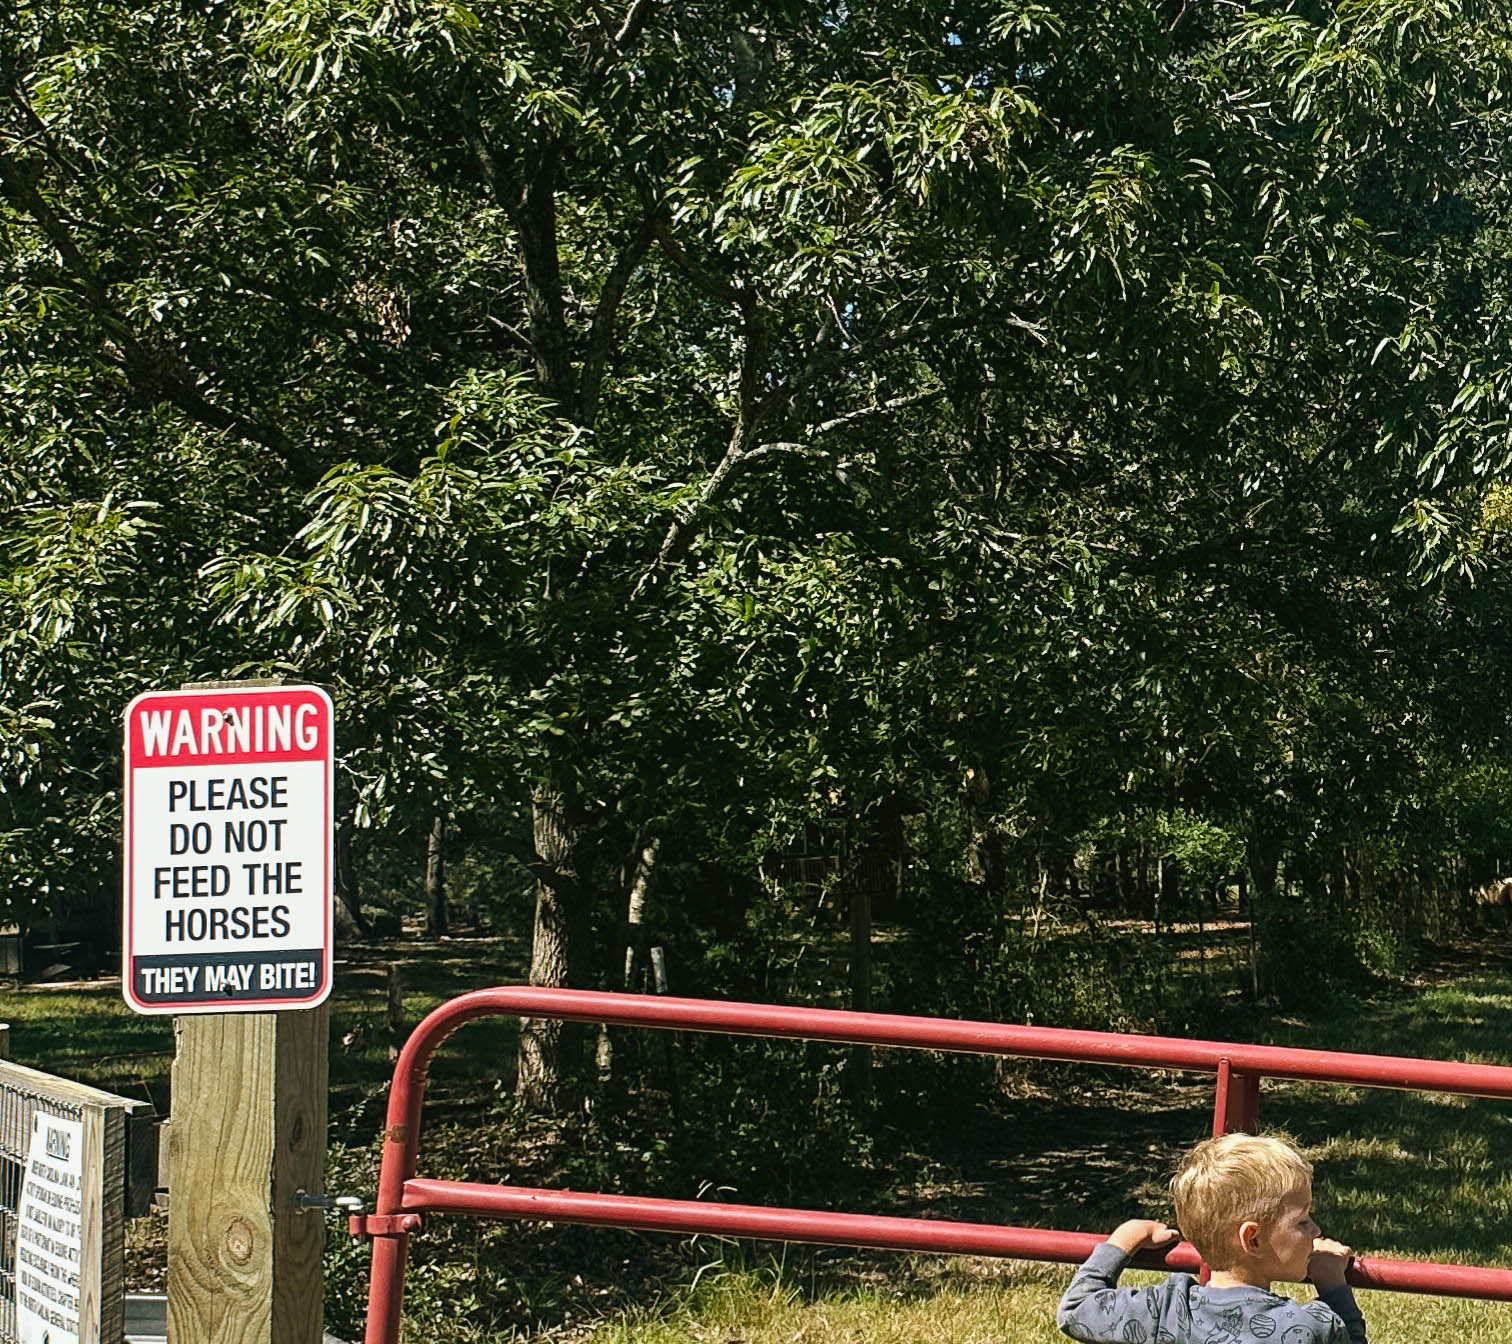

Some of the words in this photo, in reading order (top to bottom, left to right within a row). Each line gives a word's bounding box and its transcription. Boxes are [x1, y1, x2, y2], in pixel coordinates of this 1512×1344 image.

[140, 703, 319, 758] WARNING
[167, 776, 289, 813] PLEASE
[170, 821, 213, 855] DO
[224, 819, 289, 853] NOT
[154, 865, 231, 900] FEED
[242, 862, 303, 896] THE
[166, 905, 291, 943] HORSES
[141, 966, 199, 995] THEY
[204, 964, 255, 993] MAY
[260, 961, 317, 991] BITE!
